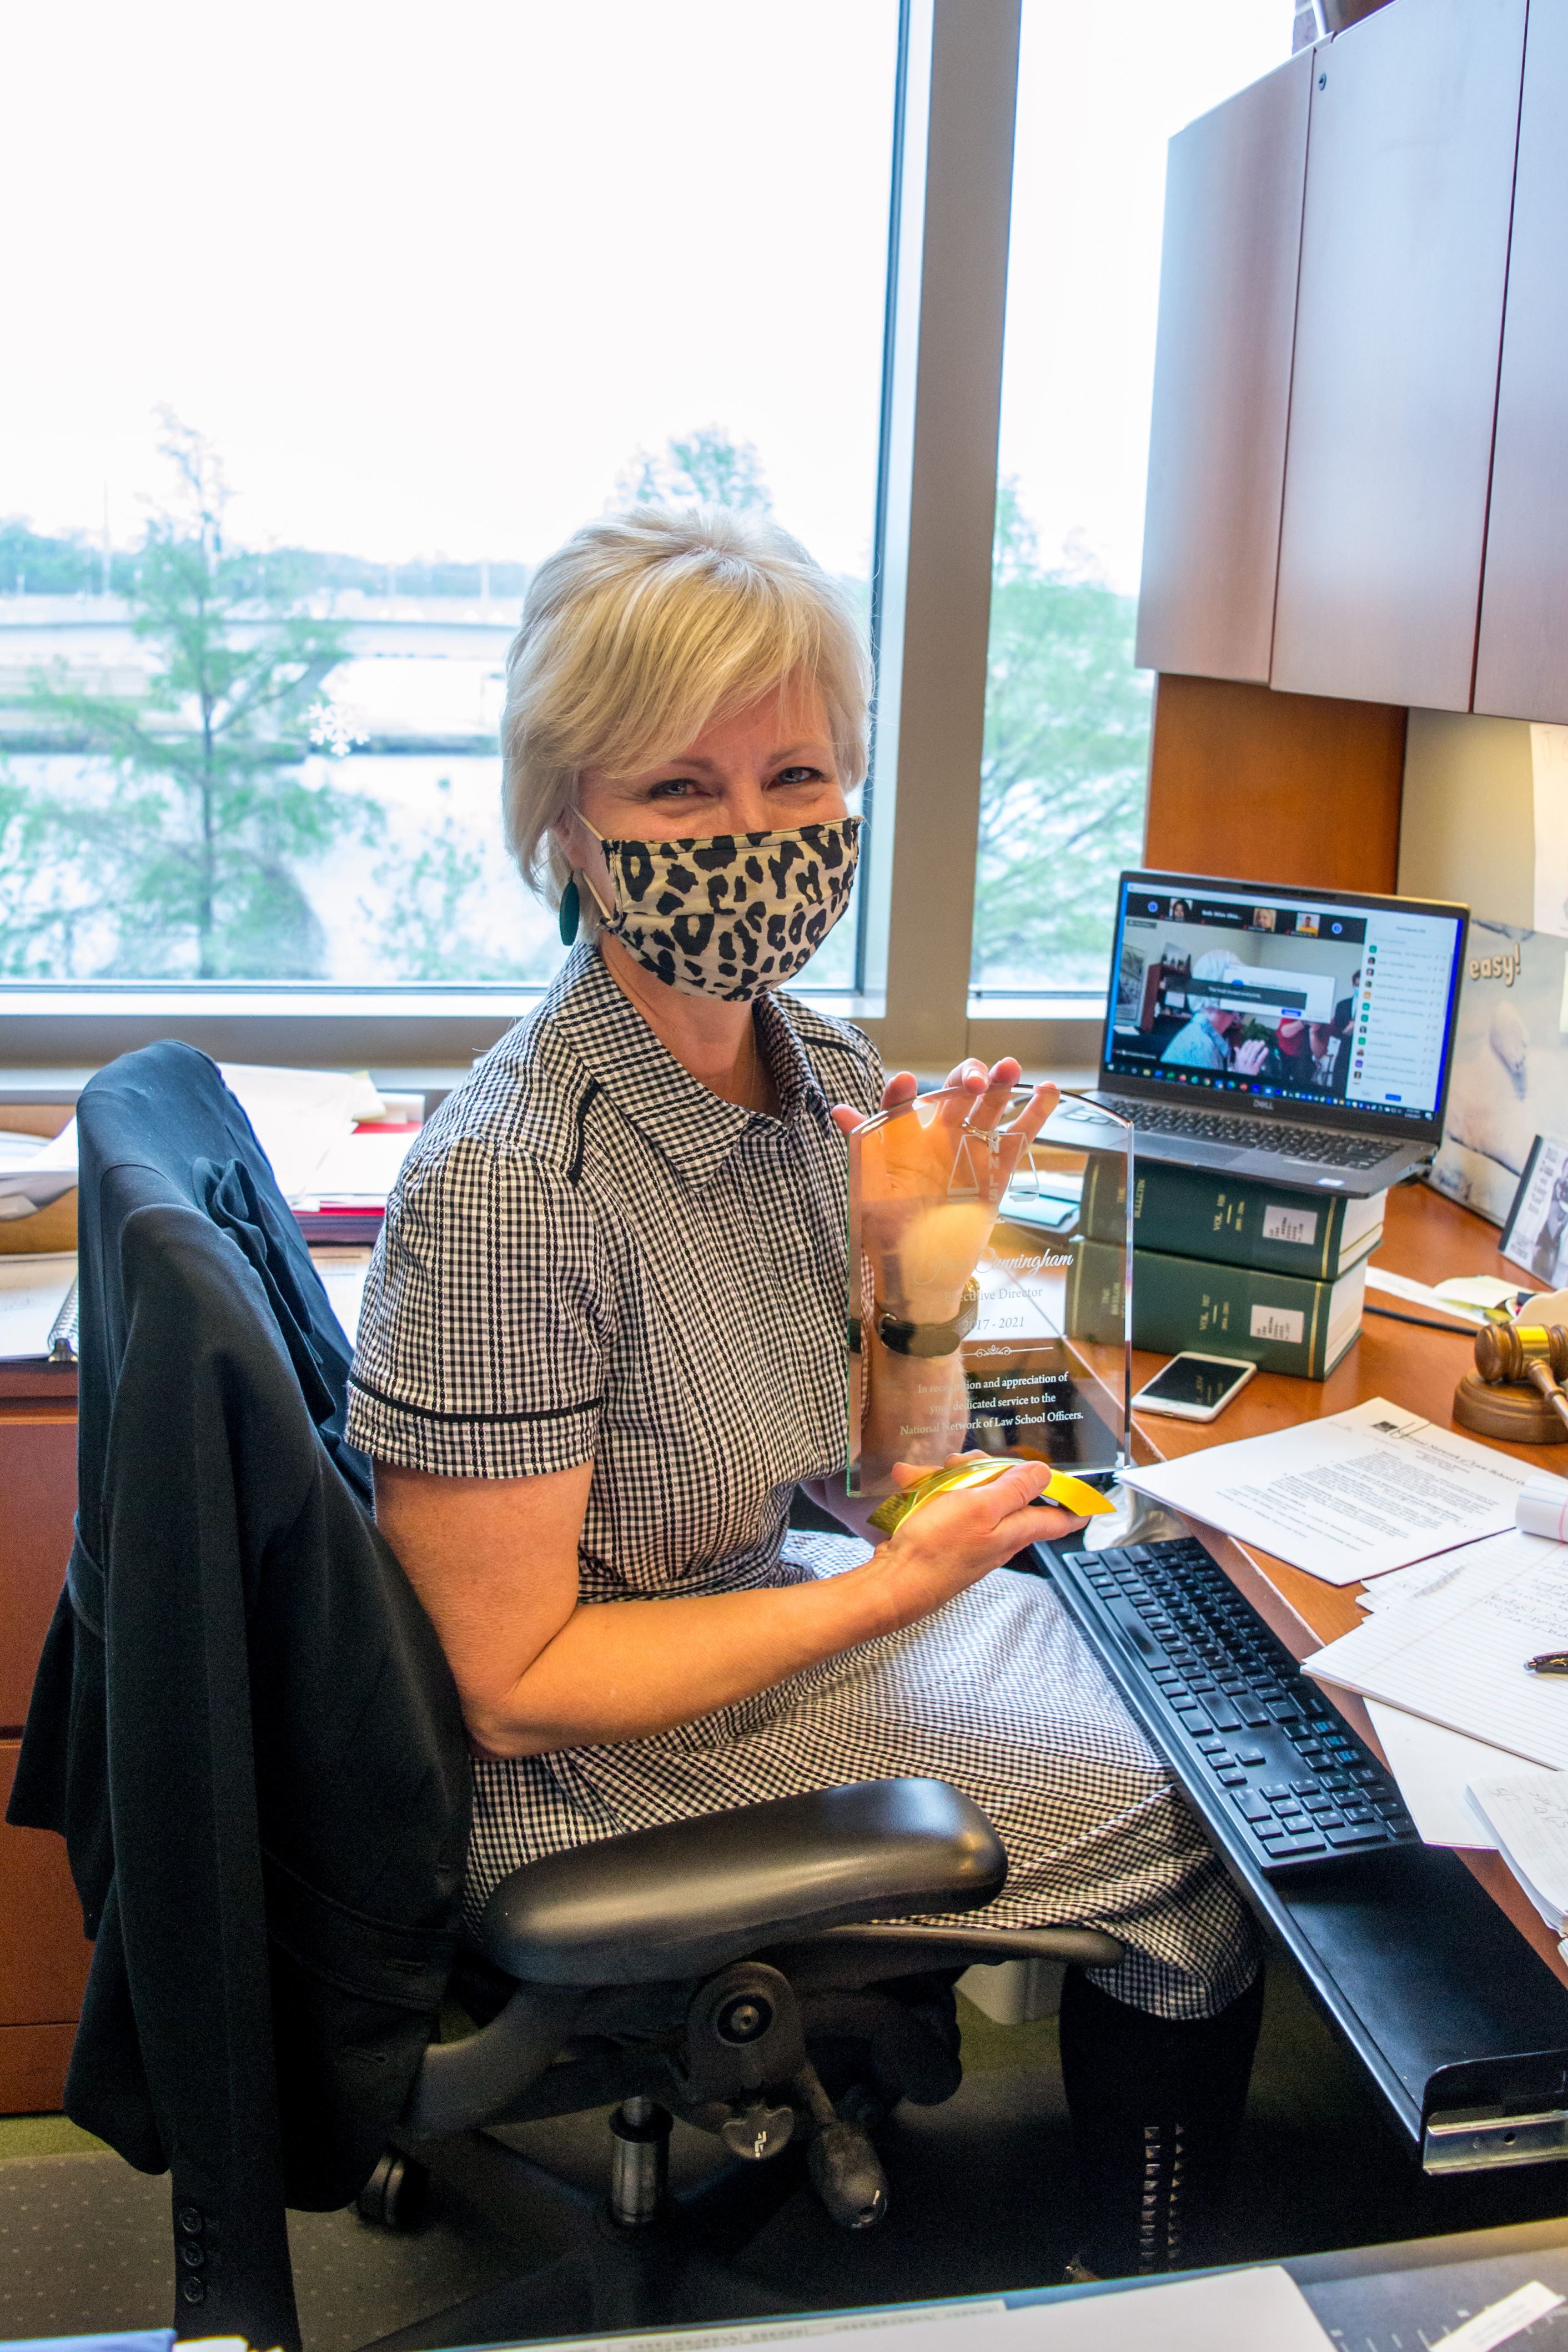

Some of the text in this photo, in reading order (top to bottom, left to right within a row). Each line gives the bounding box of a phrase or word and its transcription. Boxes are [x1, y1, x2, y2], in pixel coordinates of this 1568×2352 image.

[1469, 942, 1521, 987] easy!
[975, 1247, 1074, 1276] Cunningham
[944, 1287, 1043, 1303] Executive Director
[963, 1319, 989, 1333] 2017
[998, 1316, 1025, 1329] 2021
[918, 1370, 1069, 1395] In recognition and appreciation of
[953, 1397, 996, 1411] dedicated
[998, 1395, 1029, 1407] service
[1030, 1394, 1040, 1404] to
[1042, 1392, 1056, 1403] the
[899, 1410, 1084, 1435] National Network of Law School Officers.
